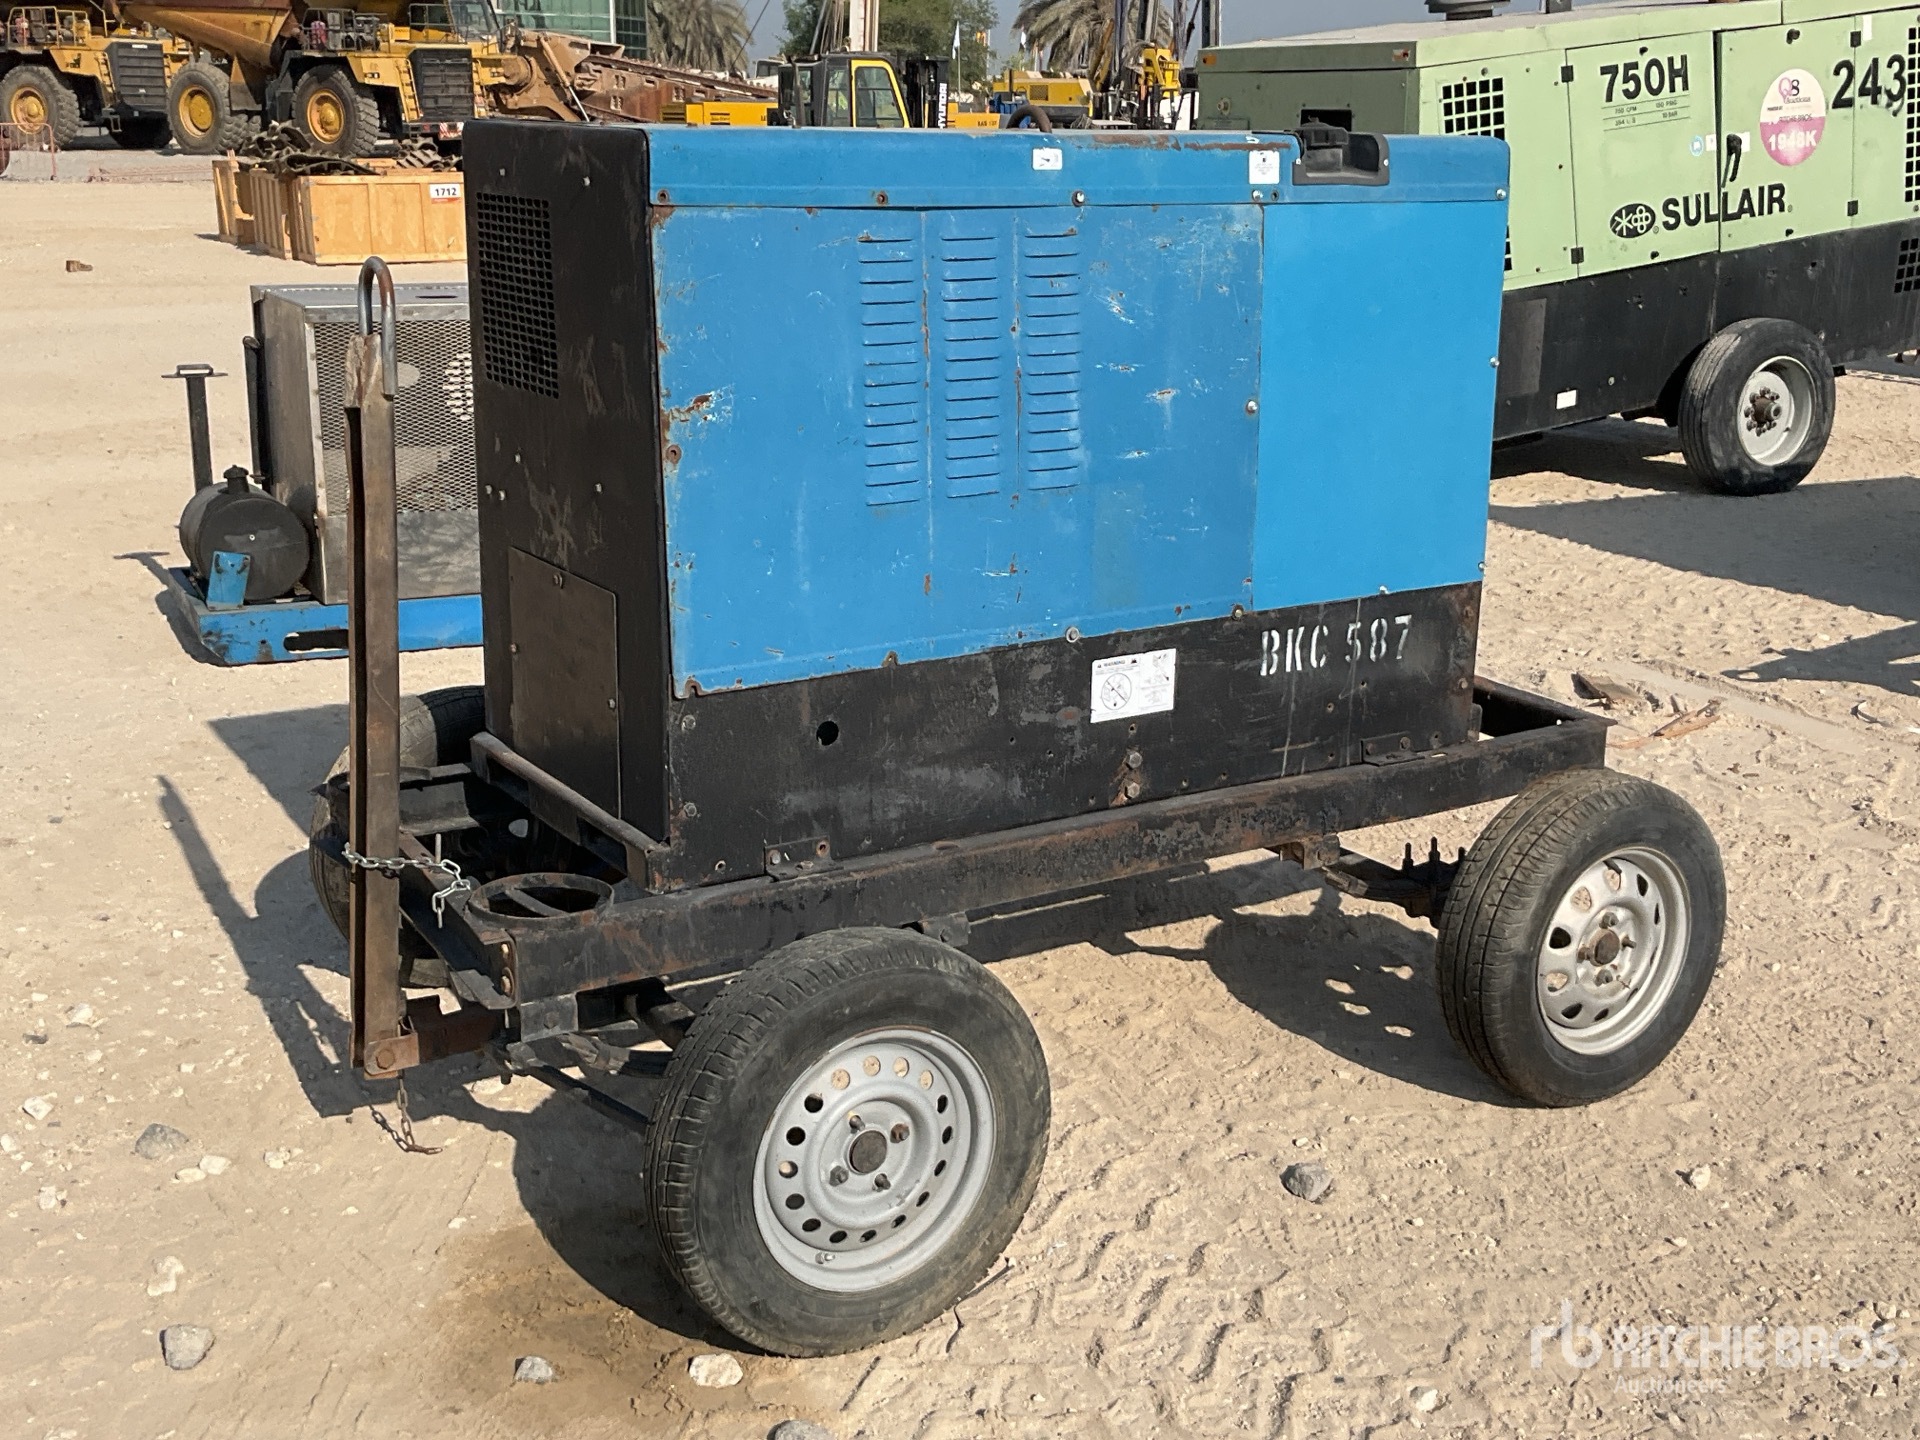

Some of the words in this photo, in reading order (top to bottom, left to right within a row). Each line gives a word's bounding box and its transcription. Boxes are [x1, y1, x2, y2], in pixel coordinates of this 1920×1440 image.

[1599, 54, 1689, 103] 750H
[1832, 53, 1906, 109] 243
[435, 187, 457, 196] 1712
[1662, 183, 1786, 231] SULLAIR
[1260, 625, 1329, 676] BKC
[1345, 614, 1412, 662] 587
